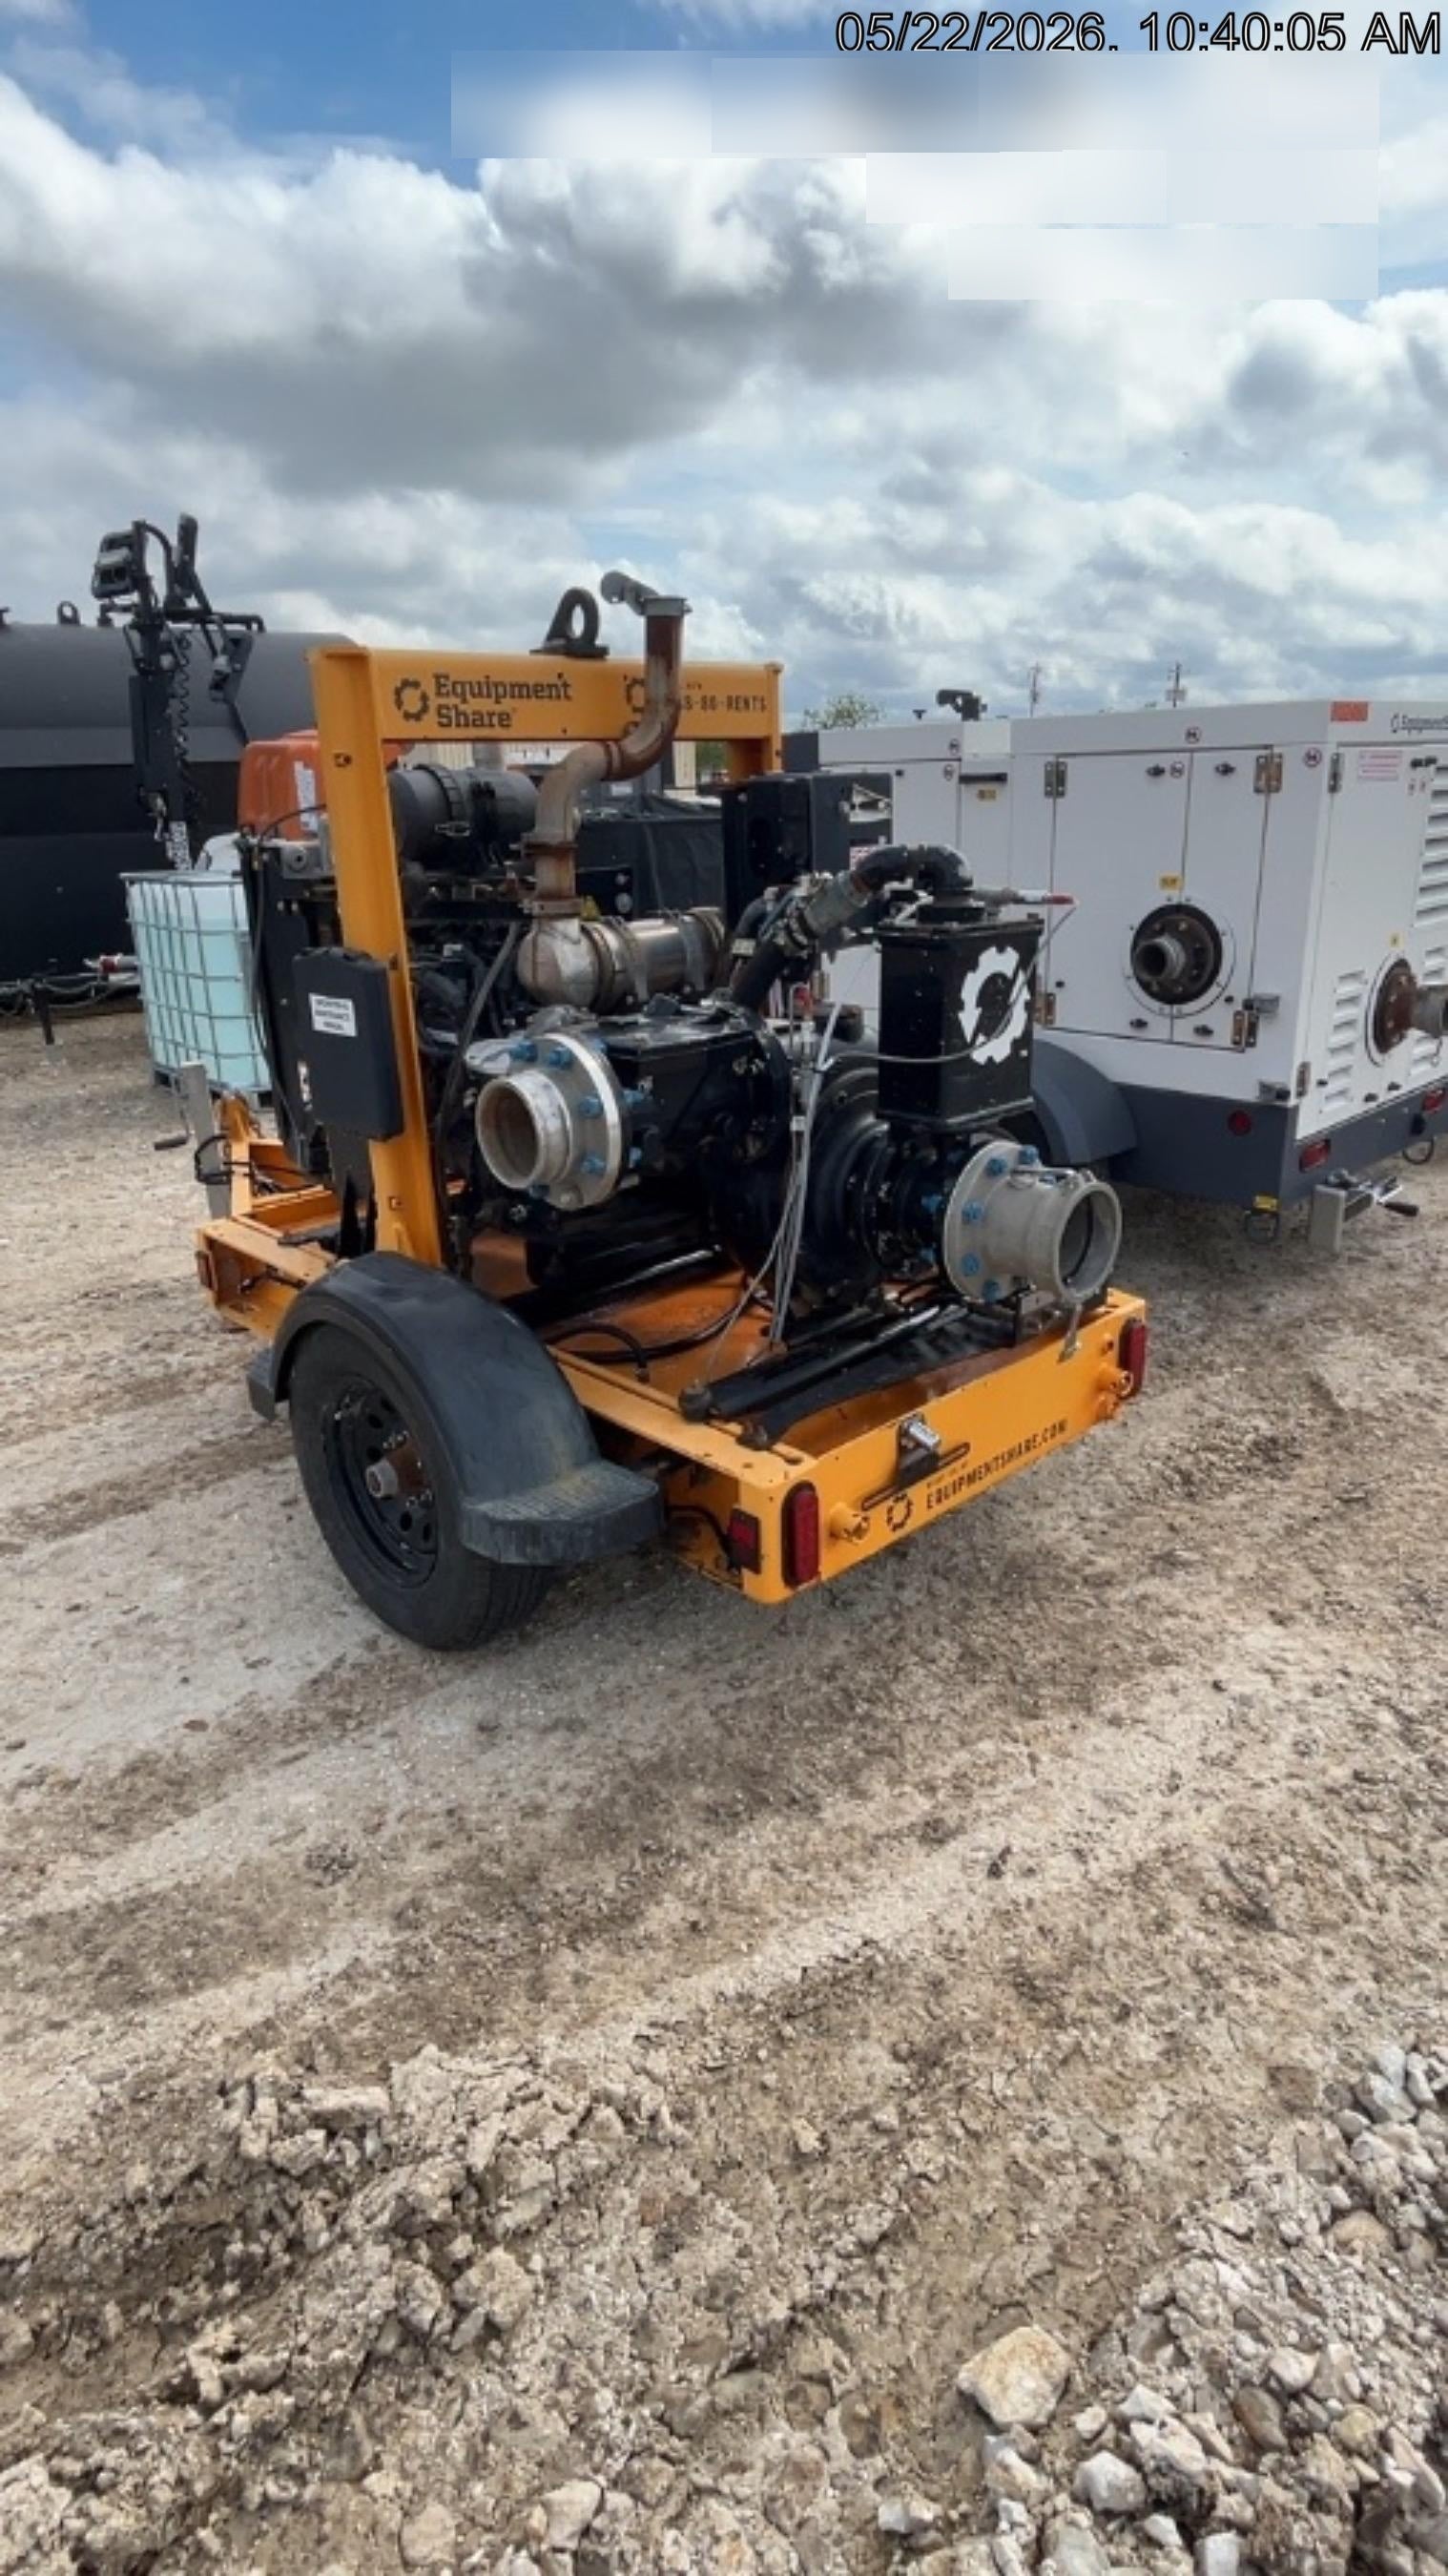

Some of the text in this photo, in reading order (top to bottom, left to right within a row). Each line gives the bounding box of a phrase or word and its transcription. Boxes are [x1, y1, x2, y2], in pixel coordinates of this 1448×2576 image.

[433, 673, 572, 704] Equipment
[437, 704, 511, 728] Share
[926, 1419, 1067, 1510] EQUIPMENTSHARE.COM
